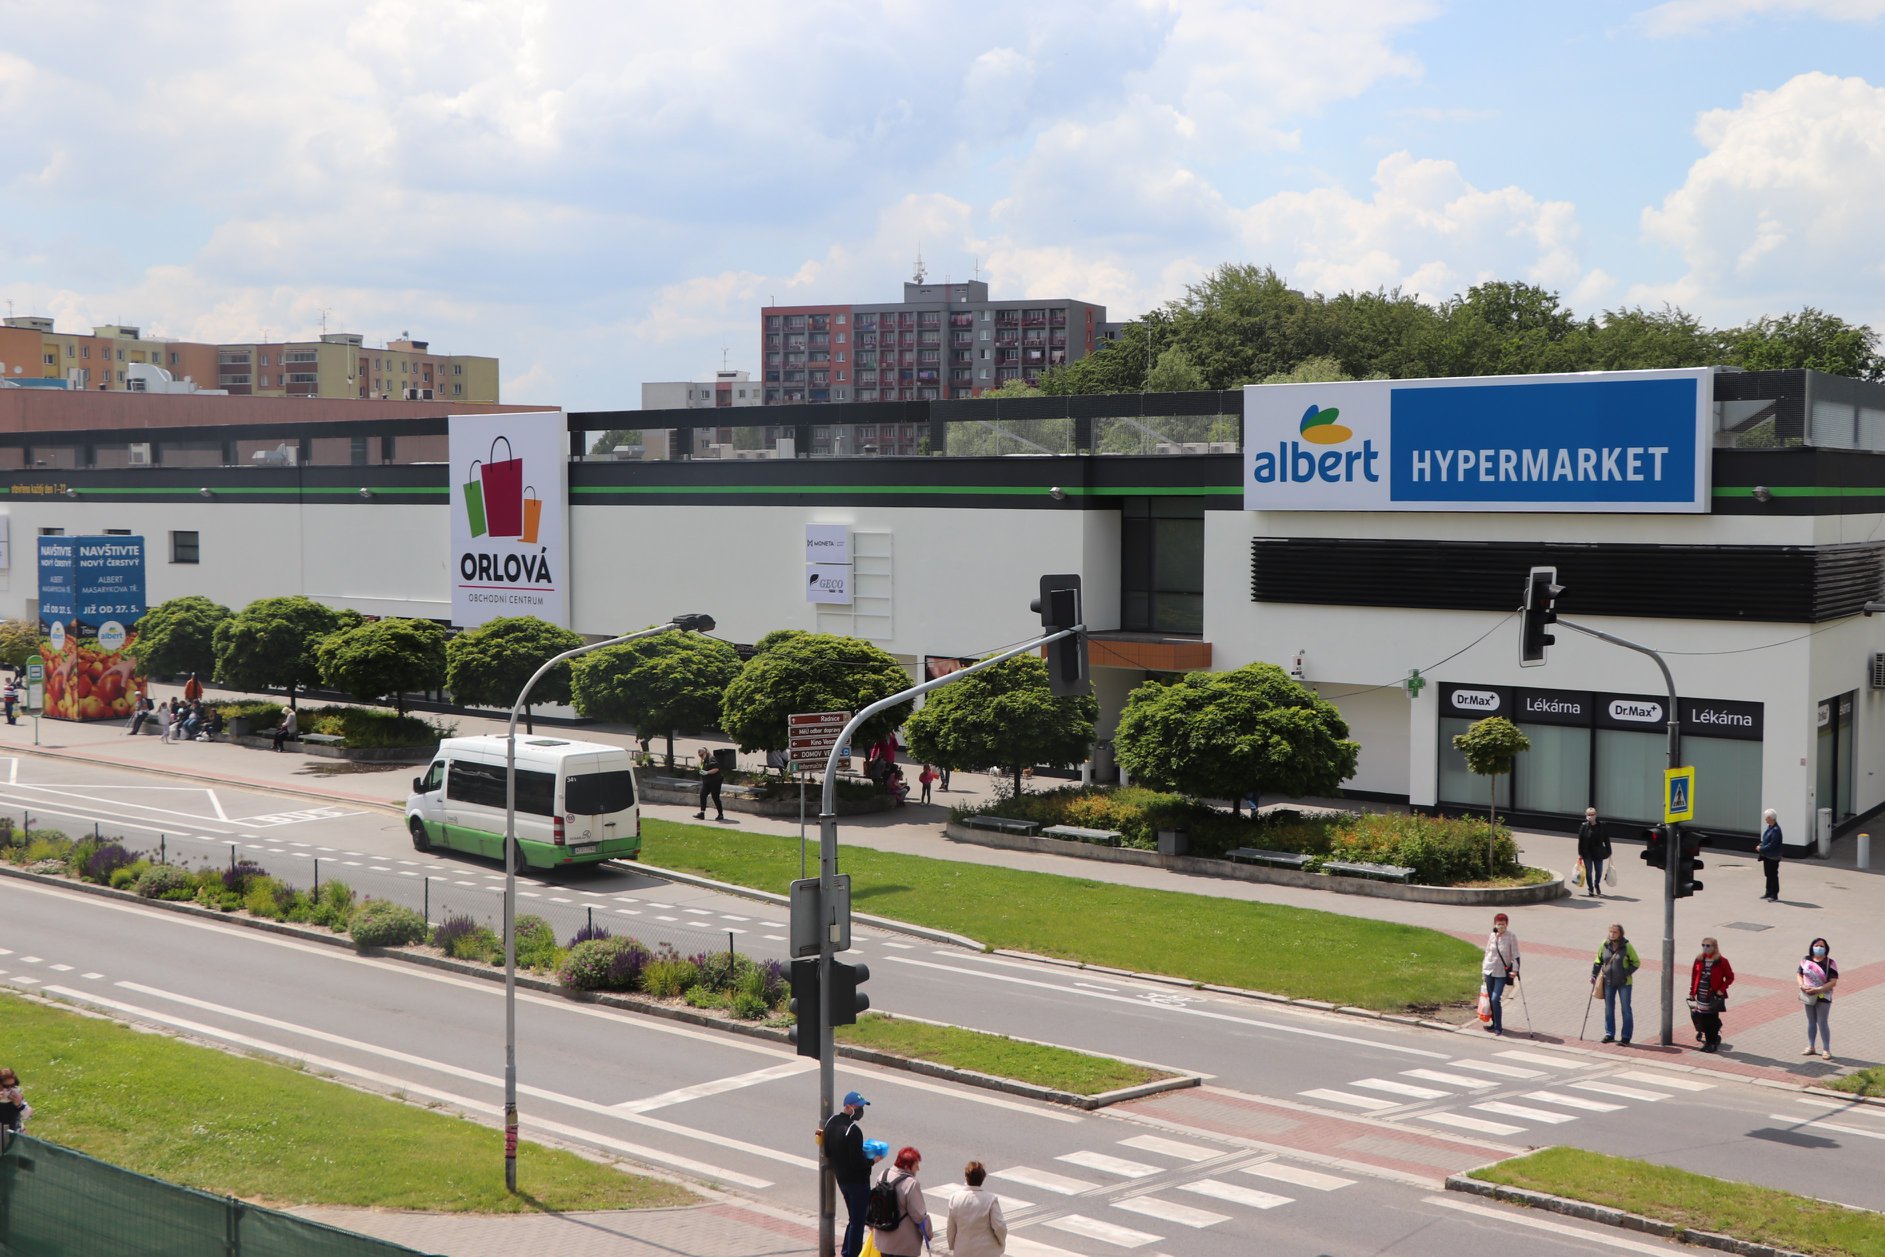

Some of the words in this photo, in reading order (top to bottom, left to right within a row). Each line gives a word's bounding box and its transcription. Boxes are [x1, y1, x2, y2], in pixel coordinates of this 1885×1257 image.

[1253, 439, 1380, 484] albert
[1411, 446, 1670, 483] HYPERMARKET
[41, 544, 72, 556] NAVŠTIVTE
[80, 543, 140, 557] NAVŠTIVTE
[80, 559, 105, 568] NOVÝ
[106, 558, 140, 568] ČERSTVÝ
[460, 546, 553, 584] ORLOVÁ
[97, 575, 123, 584] ALBERT
[819, 579, 844, 589] GECO
[81, 585, 128, 594] MASARYKOVA
[468, 593, 508, 604] OBCHODNÍ
[509, 595, 544, 606] CENTRUM
[83, 604, 97, 615] JIŽ
[98, 605, 113, 614] OD
[115, 604, 129, 614] 27.
[130, 604, 140, 613] 5.
[1526, 697, 1581, 714] Lékárna
[1691, 708, 1753, 727] Lékárna
[254, 810, 342, 823] BUS
